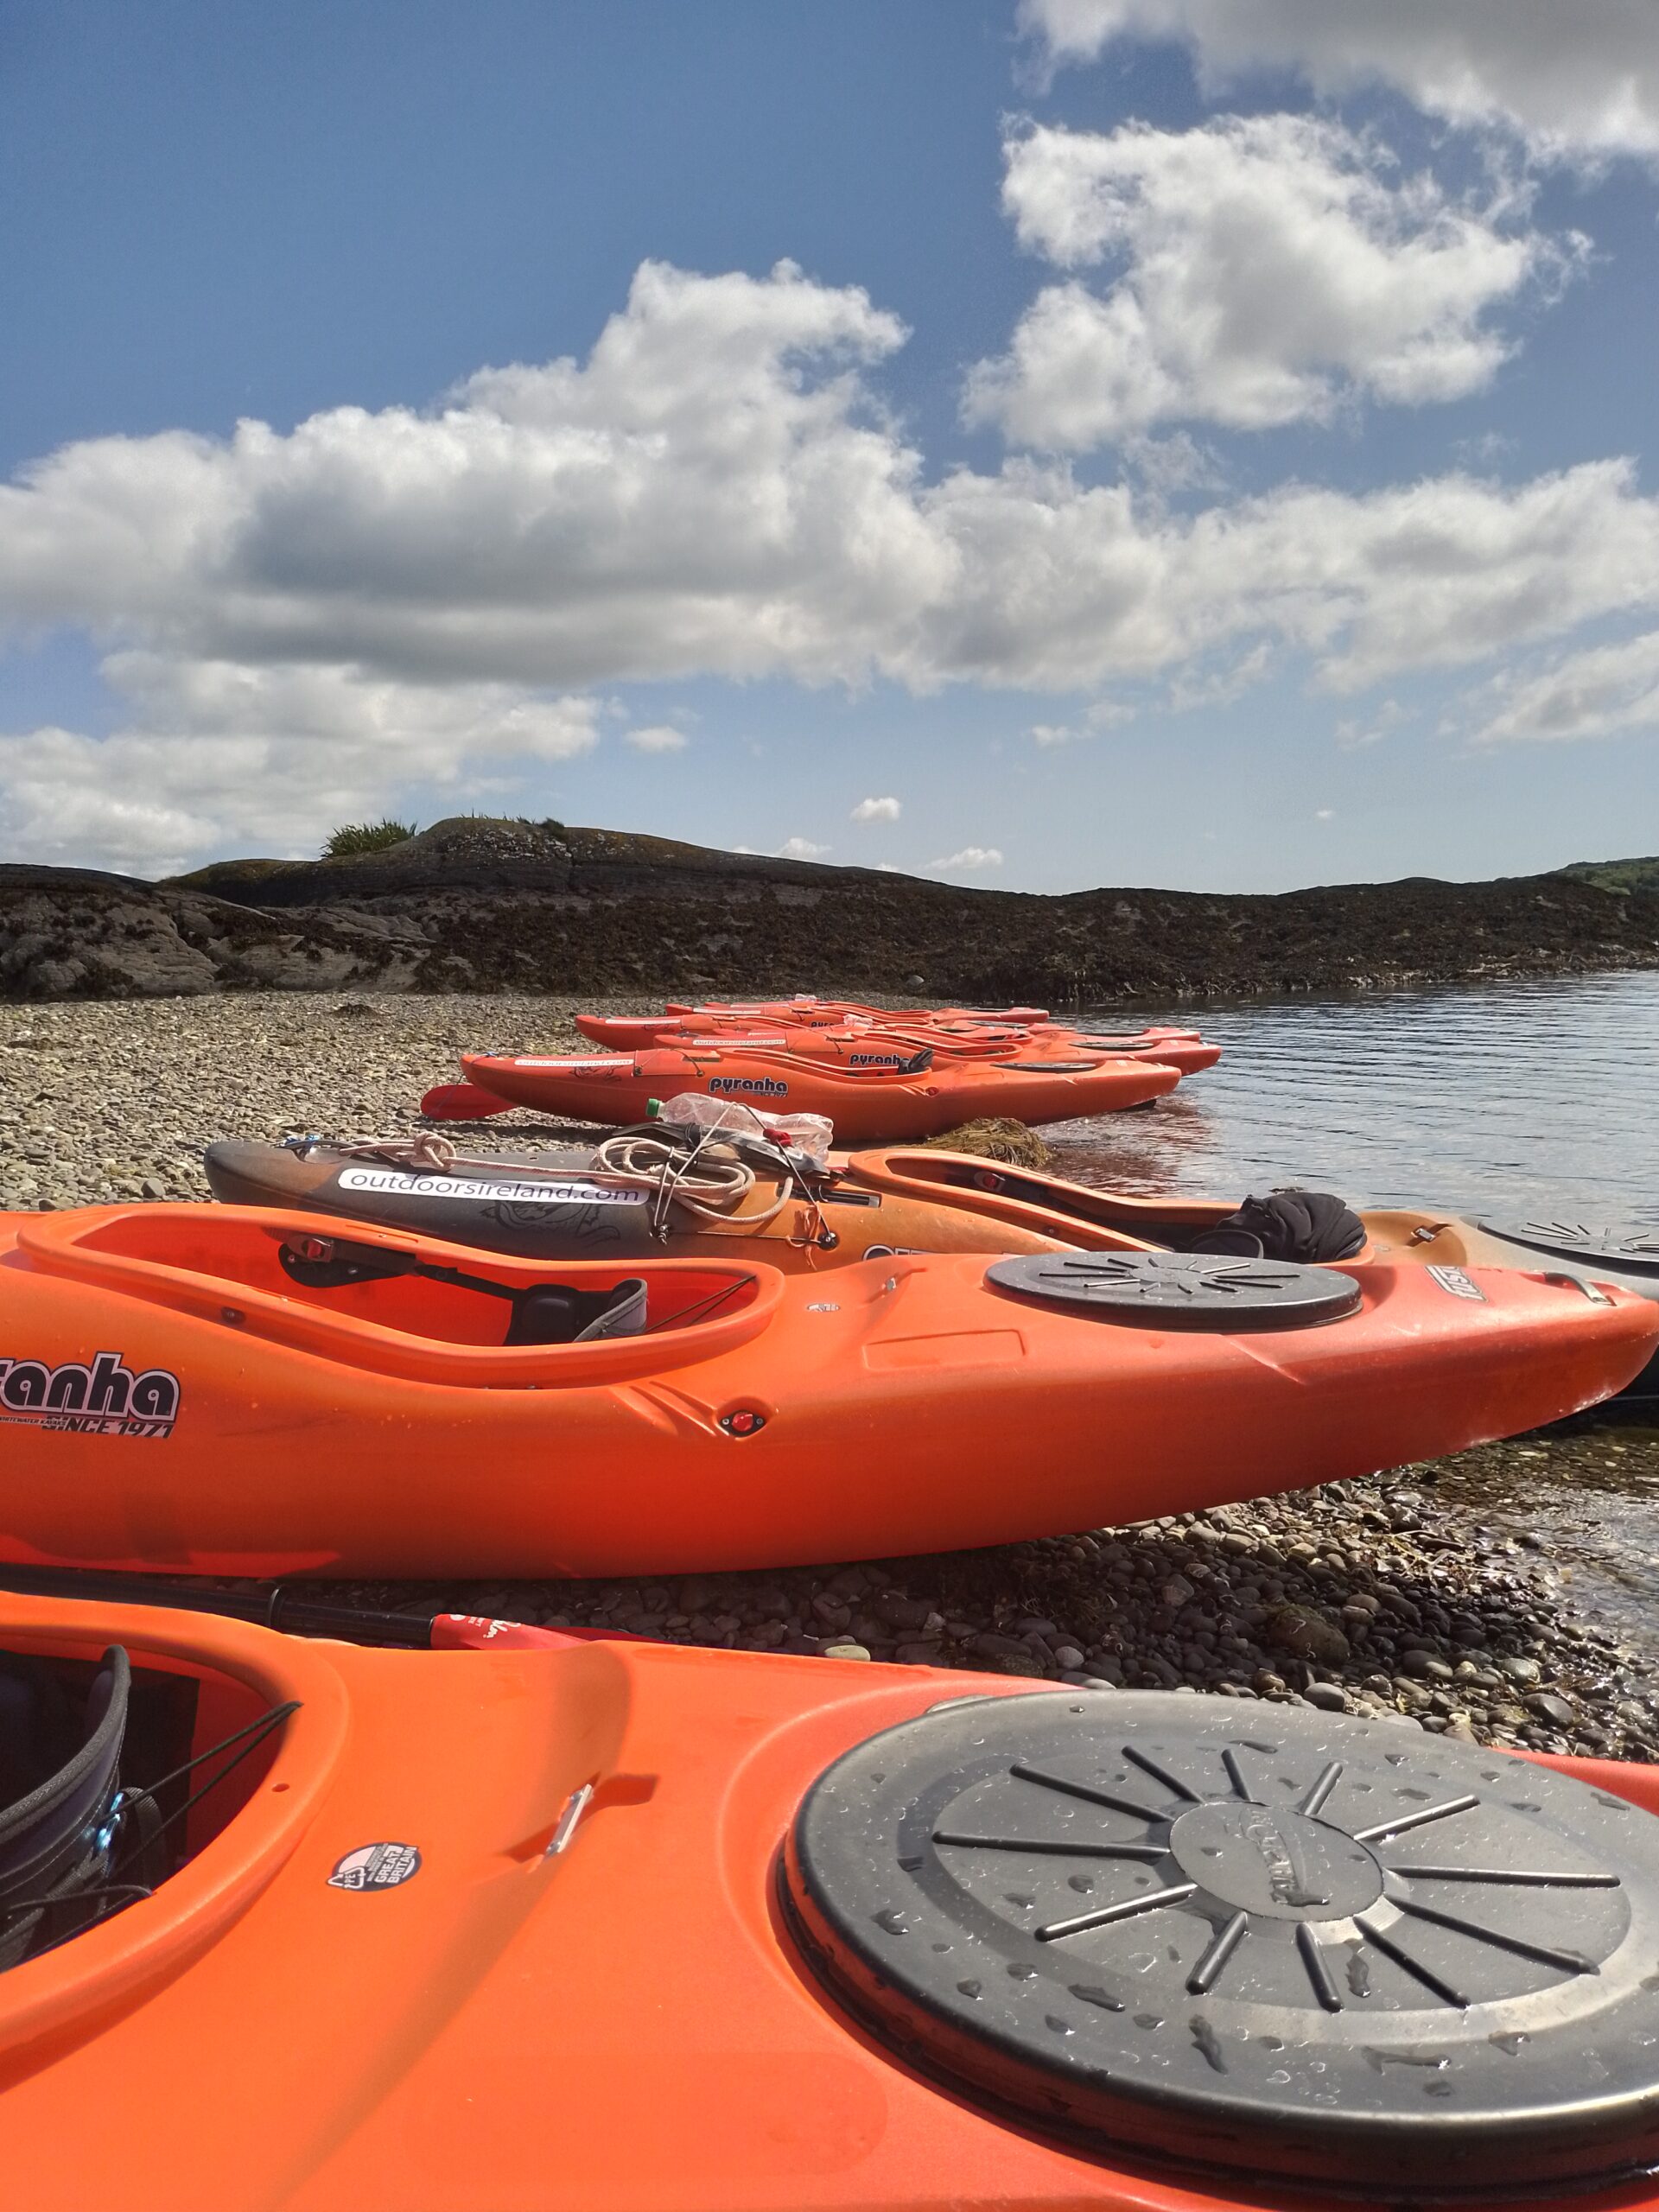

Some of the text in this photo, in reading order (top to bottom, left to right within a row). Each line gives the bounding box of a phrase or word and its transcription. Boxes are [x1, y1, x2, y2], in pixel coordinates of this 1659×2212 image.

[709, 1077, 789, 1094] pyranha
[350, 1173, 639, 1202] outdoorsireland.com
[118, 1421, 174, 1438] 1971
[374, 1851, 401, 1883] GREAT
[387, 1847, 417, 1883] BRITAIN
